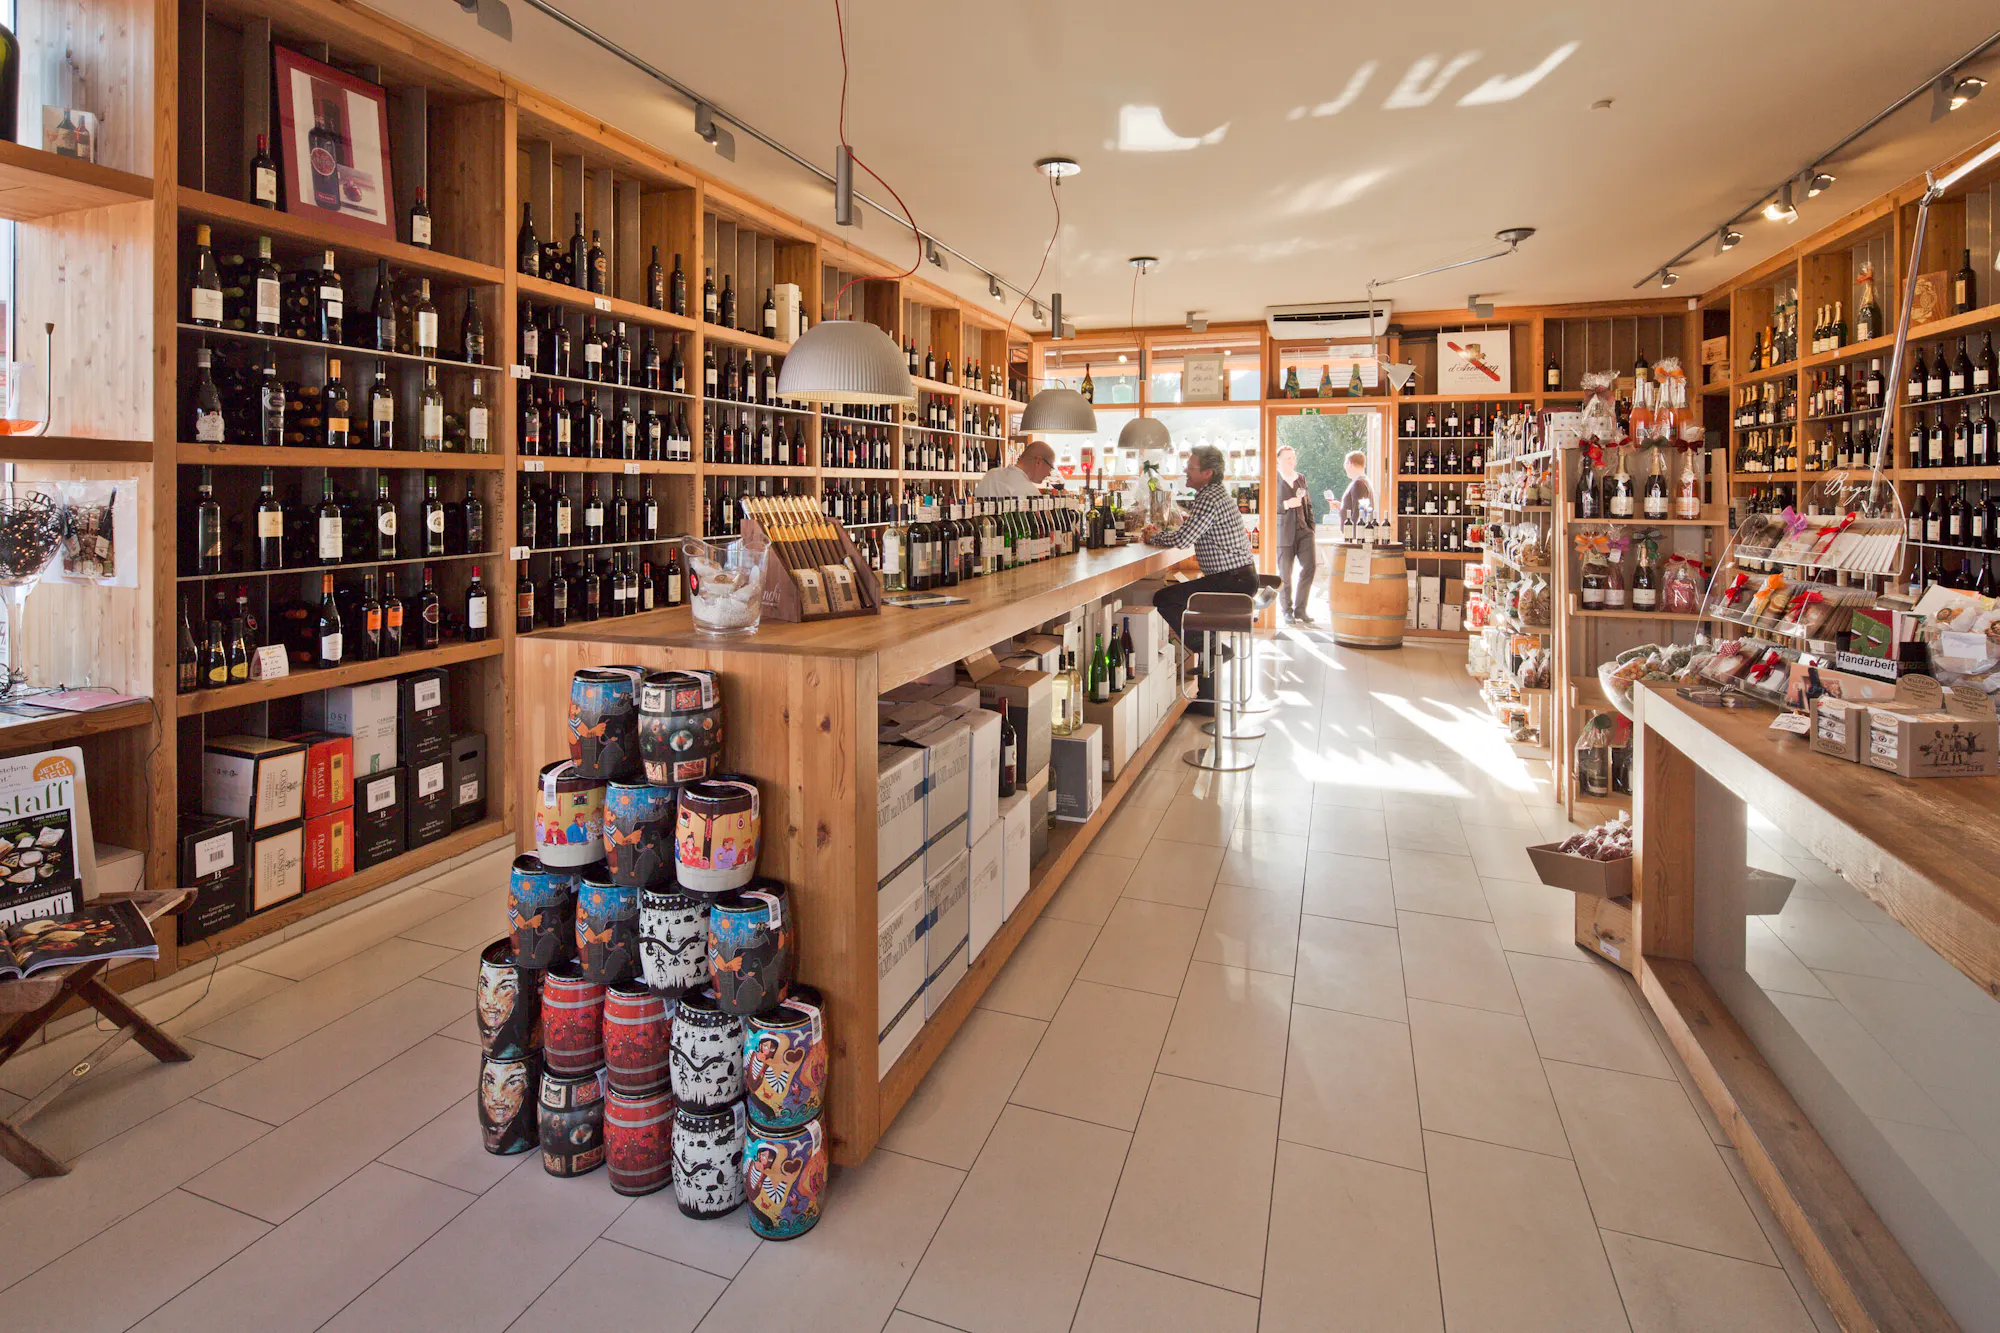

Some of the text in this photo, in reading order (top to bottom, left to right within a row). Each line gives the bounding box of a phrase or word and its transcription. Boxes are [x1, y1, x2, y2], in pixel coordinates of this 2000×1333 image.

[1837, 652, 1896, 672] Handarbeit
[38, 760, 66, 776] JETZT
[40, 766, 72, 780] NEU!
[277, 769, 289, 808] COSSETTI
[317, 762, 325, 800] FRAGILE
[429, 793, 435, 801] B
[380, 810, 387, 819] B
[317, 833, 325, 871] FRAGILE
[214, 870, 222, 880] B
[277, 848, 286, 887] COSSETTI
[29, 891, 49, 900] ESSEN
[50, 886, 72, 895] REISEN
